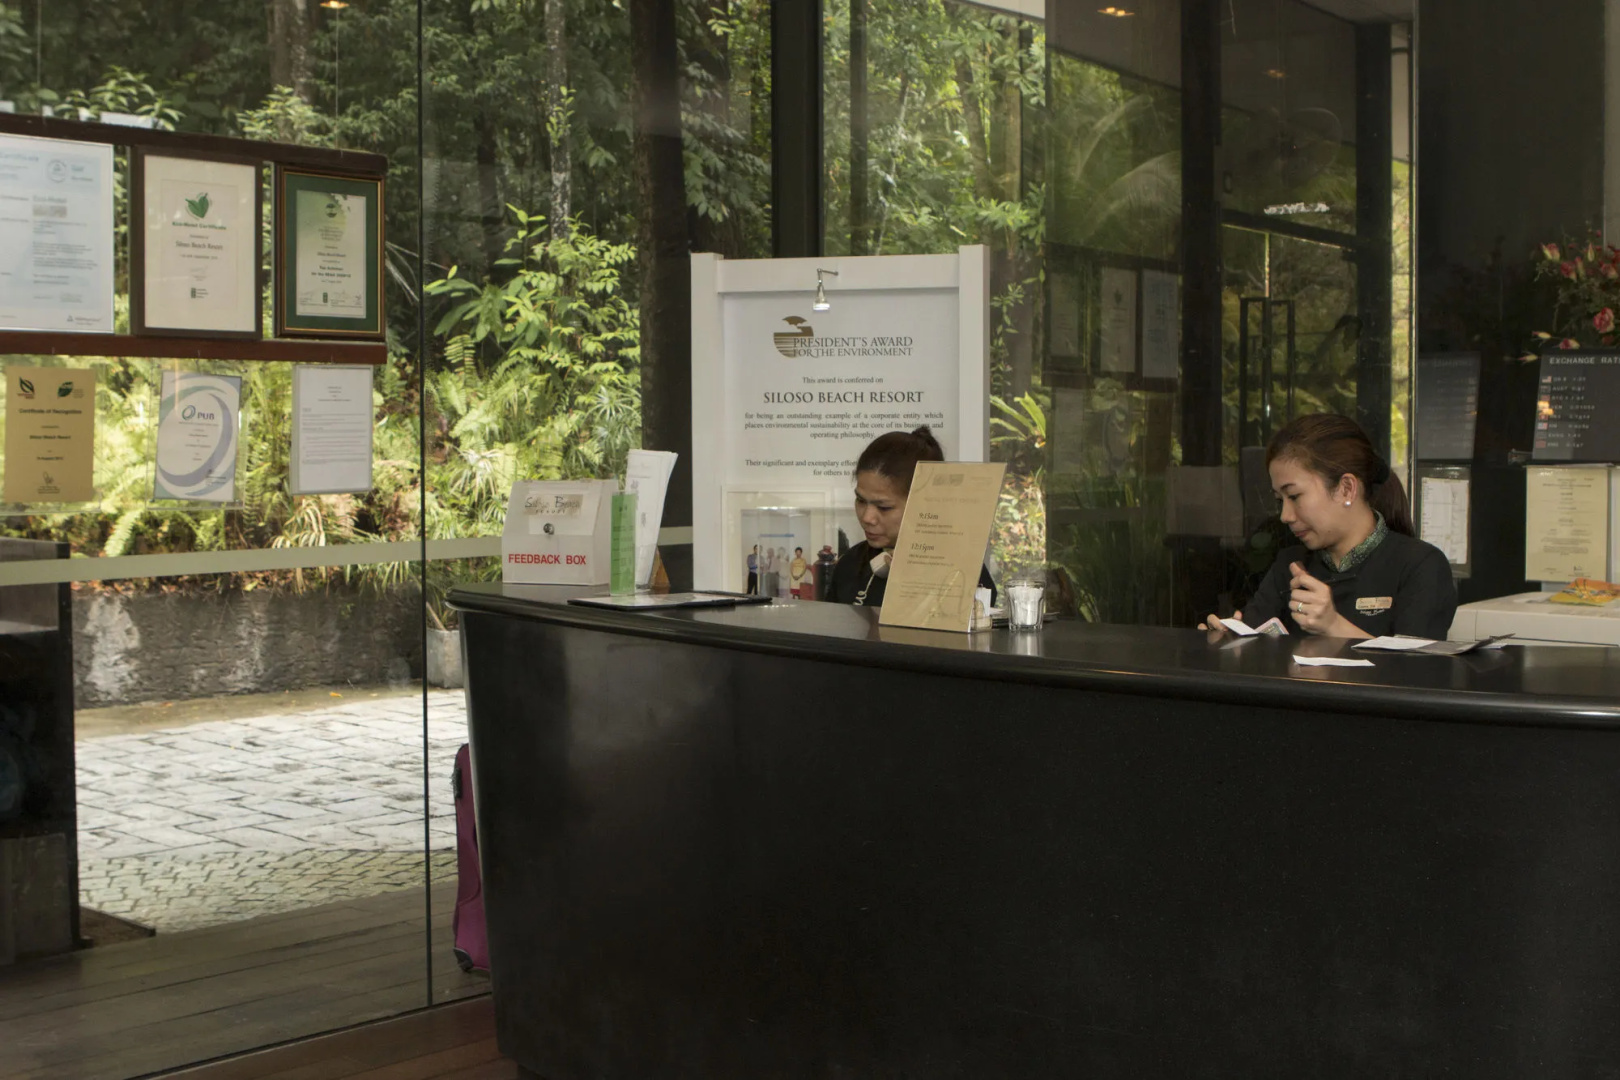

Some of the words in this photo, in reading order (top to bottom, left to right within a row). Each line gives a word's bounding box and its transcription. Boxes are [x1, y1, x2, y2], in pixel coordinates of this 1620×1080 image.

[793, 336, 868, 347] PRESIDENT'S
[870, 336, 913, 346] AWARD
[793, 348, 818, 358] FOR
[814, 348, 835, 357] THE
[838, 347, 913, 356] ENVIRONMENT
[1549, 356, 1595, 364] EXCHANGE
[764, 392, 814, 404] SILOSO
[818, 391, 864, 403] BEACH
[870, 391, 924, 403] RESORT
[197, 412, 215, 420] PUB
[756, 413, 774, 421] being
[787, 413, 822, 421] outstanding
[825, 413, 851, 421] example
[870, 413, 900, 421] corporate
[903, 413, 921, 421] entity
[745, 422, 763, 430] places
[810, 422, 850, 430] sustainability
[762, 459, 794, 467] significant
[508, 553, 561, 564] FEEDBACK
[566, 555, 587, 565] BOX
